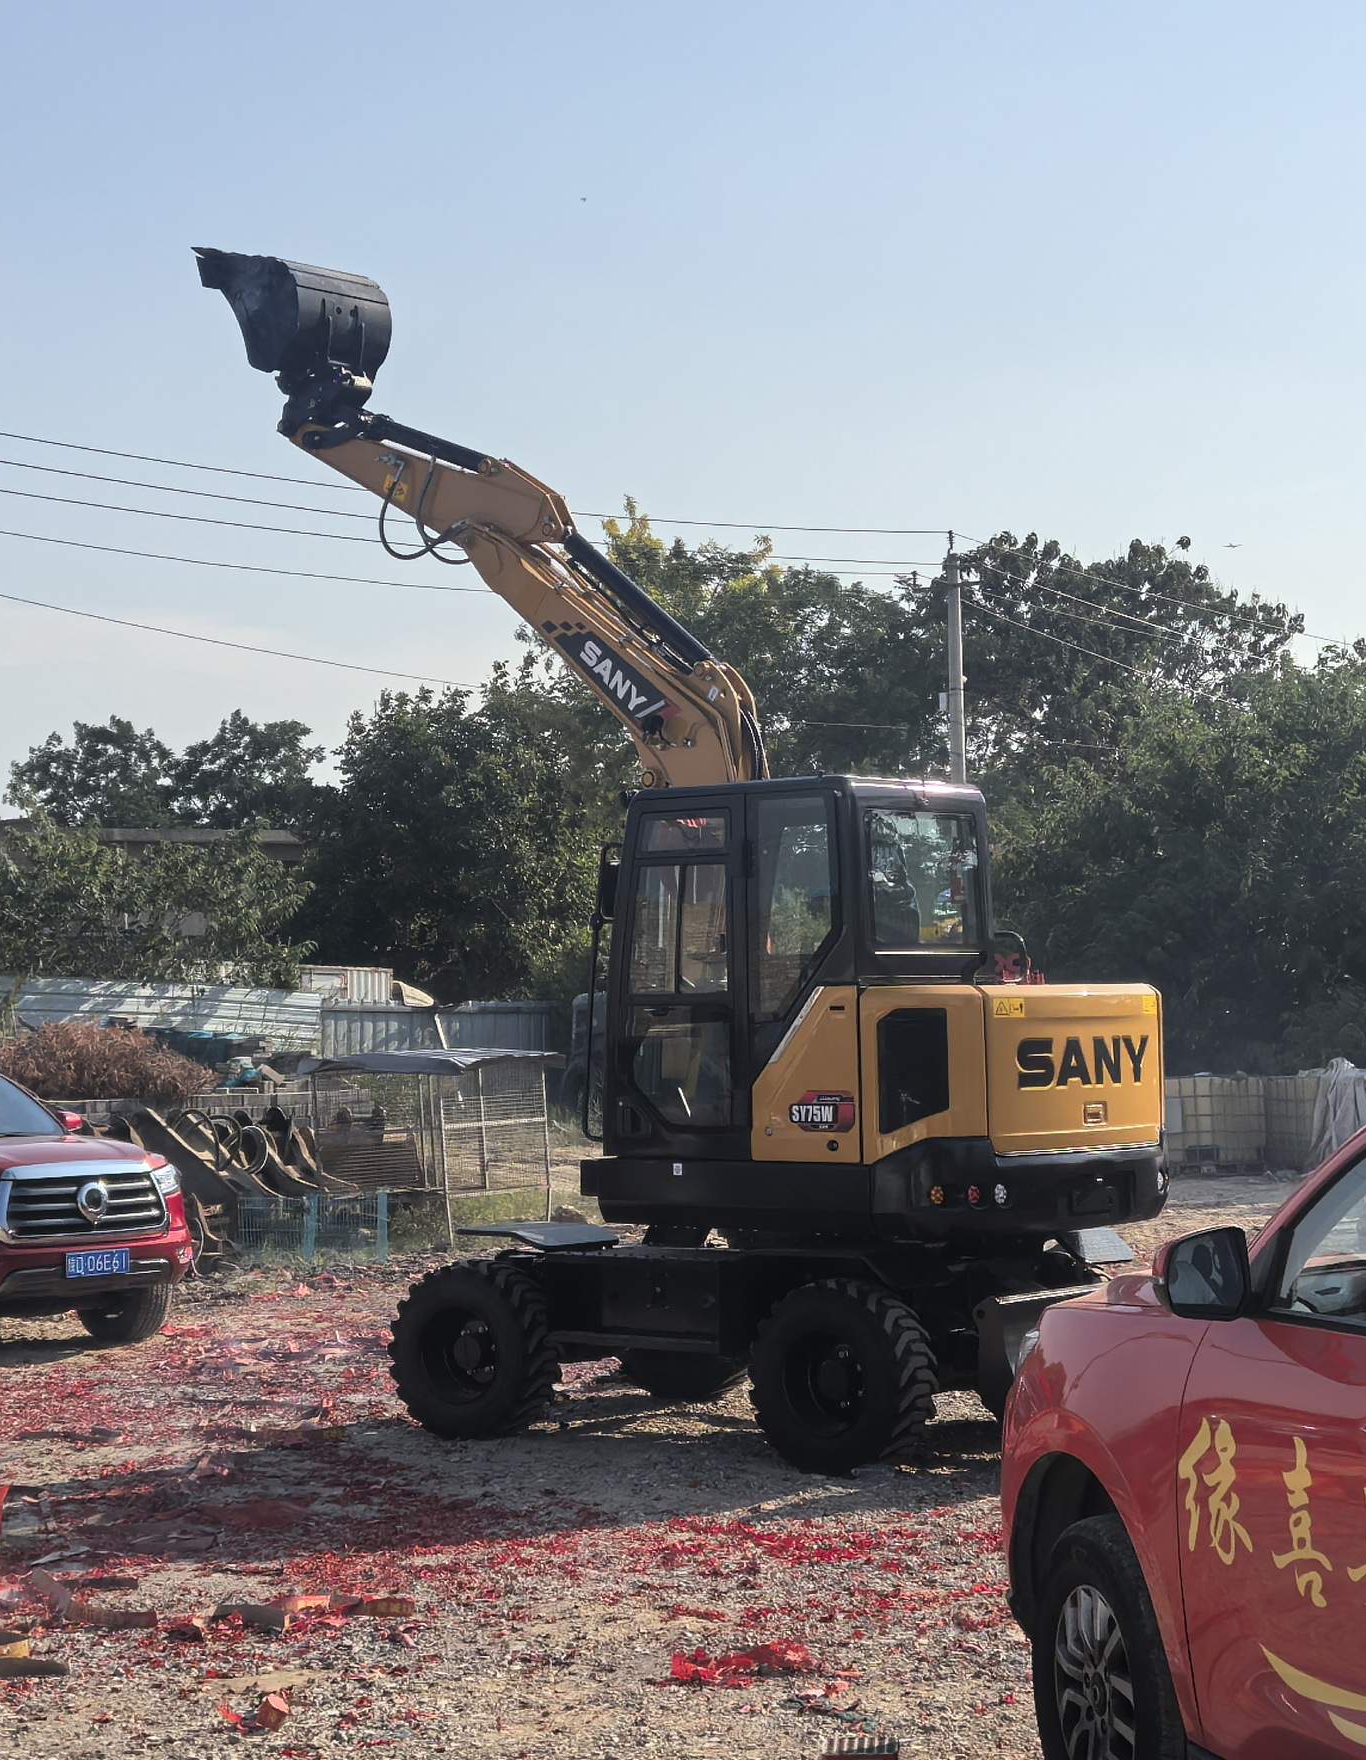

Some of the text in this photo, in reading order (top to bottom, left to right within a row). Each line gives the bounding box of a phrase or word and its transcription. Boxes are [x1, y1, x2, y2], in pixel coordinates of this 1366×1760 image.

[579, 640, 648, 711] SANY
[1017, 1035, 1149, 1091] SANY
[792, 1105, 833, 1122] SY75W
